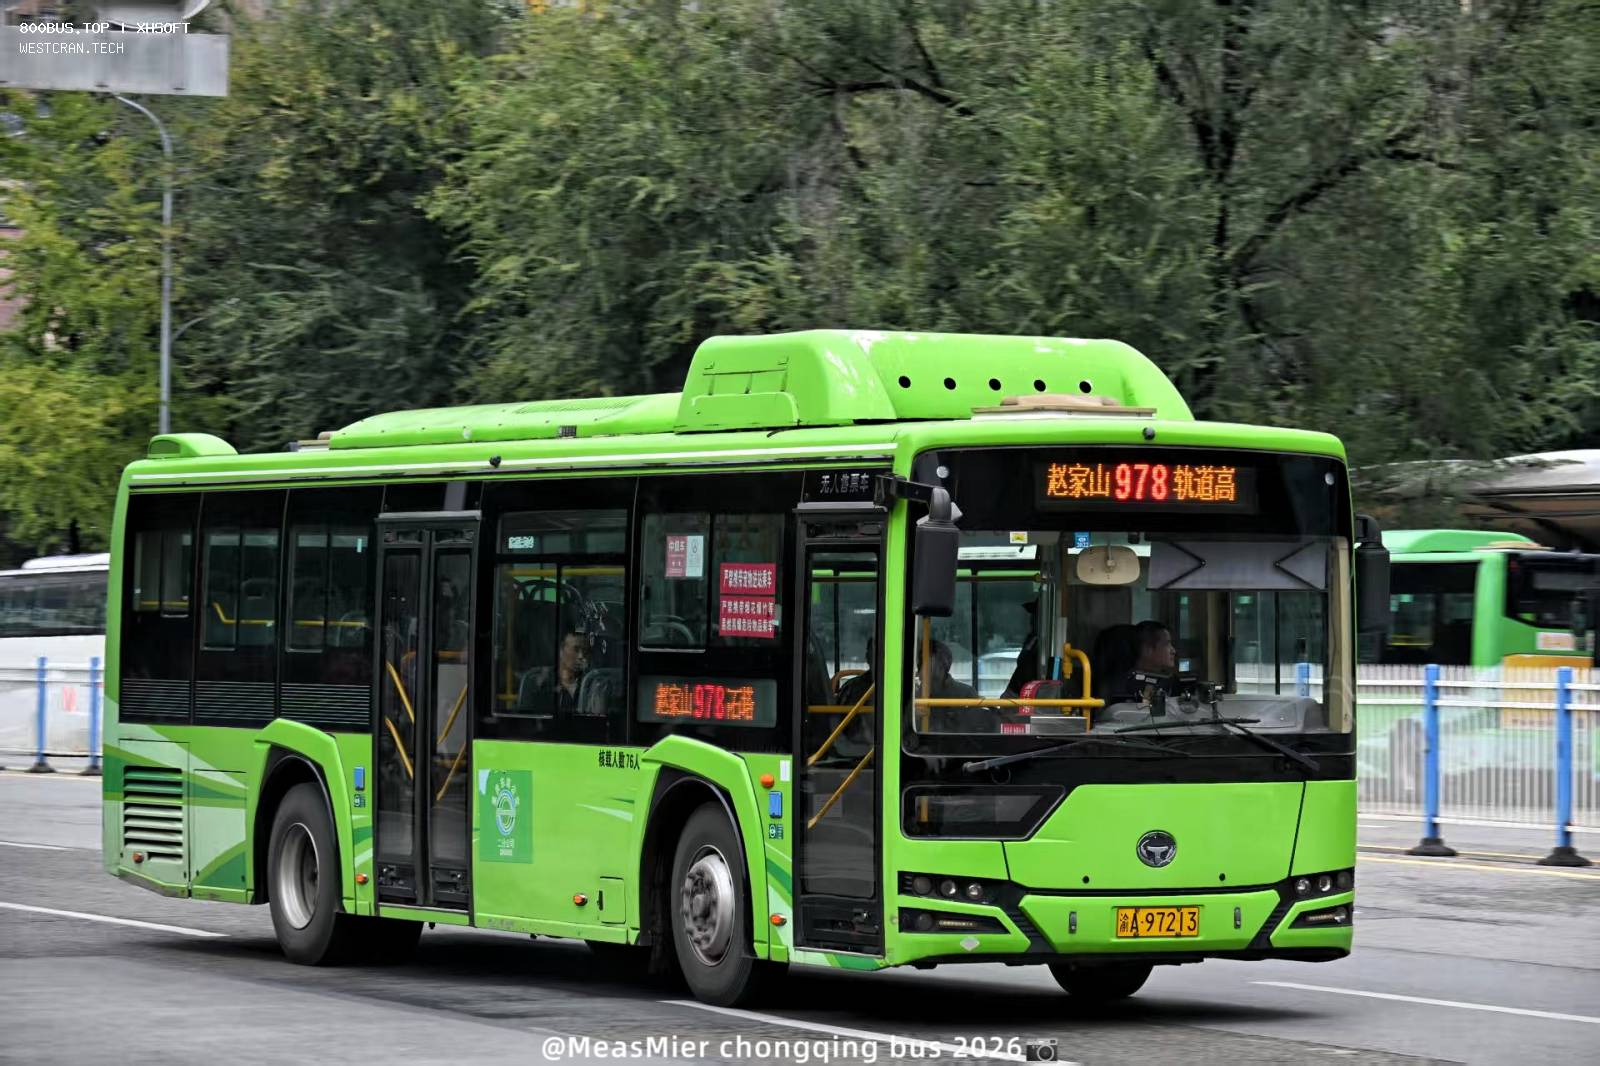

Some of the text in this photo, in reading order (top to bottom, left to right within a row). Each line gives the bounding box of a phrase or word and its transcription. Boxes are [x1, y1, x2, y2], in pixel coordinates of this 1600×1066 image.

[1047, 462, 1235, 501] 赵家山 978 轨道高
[694, 684, 725, 719] 978
